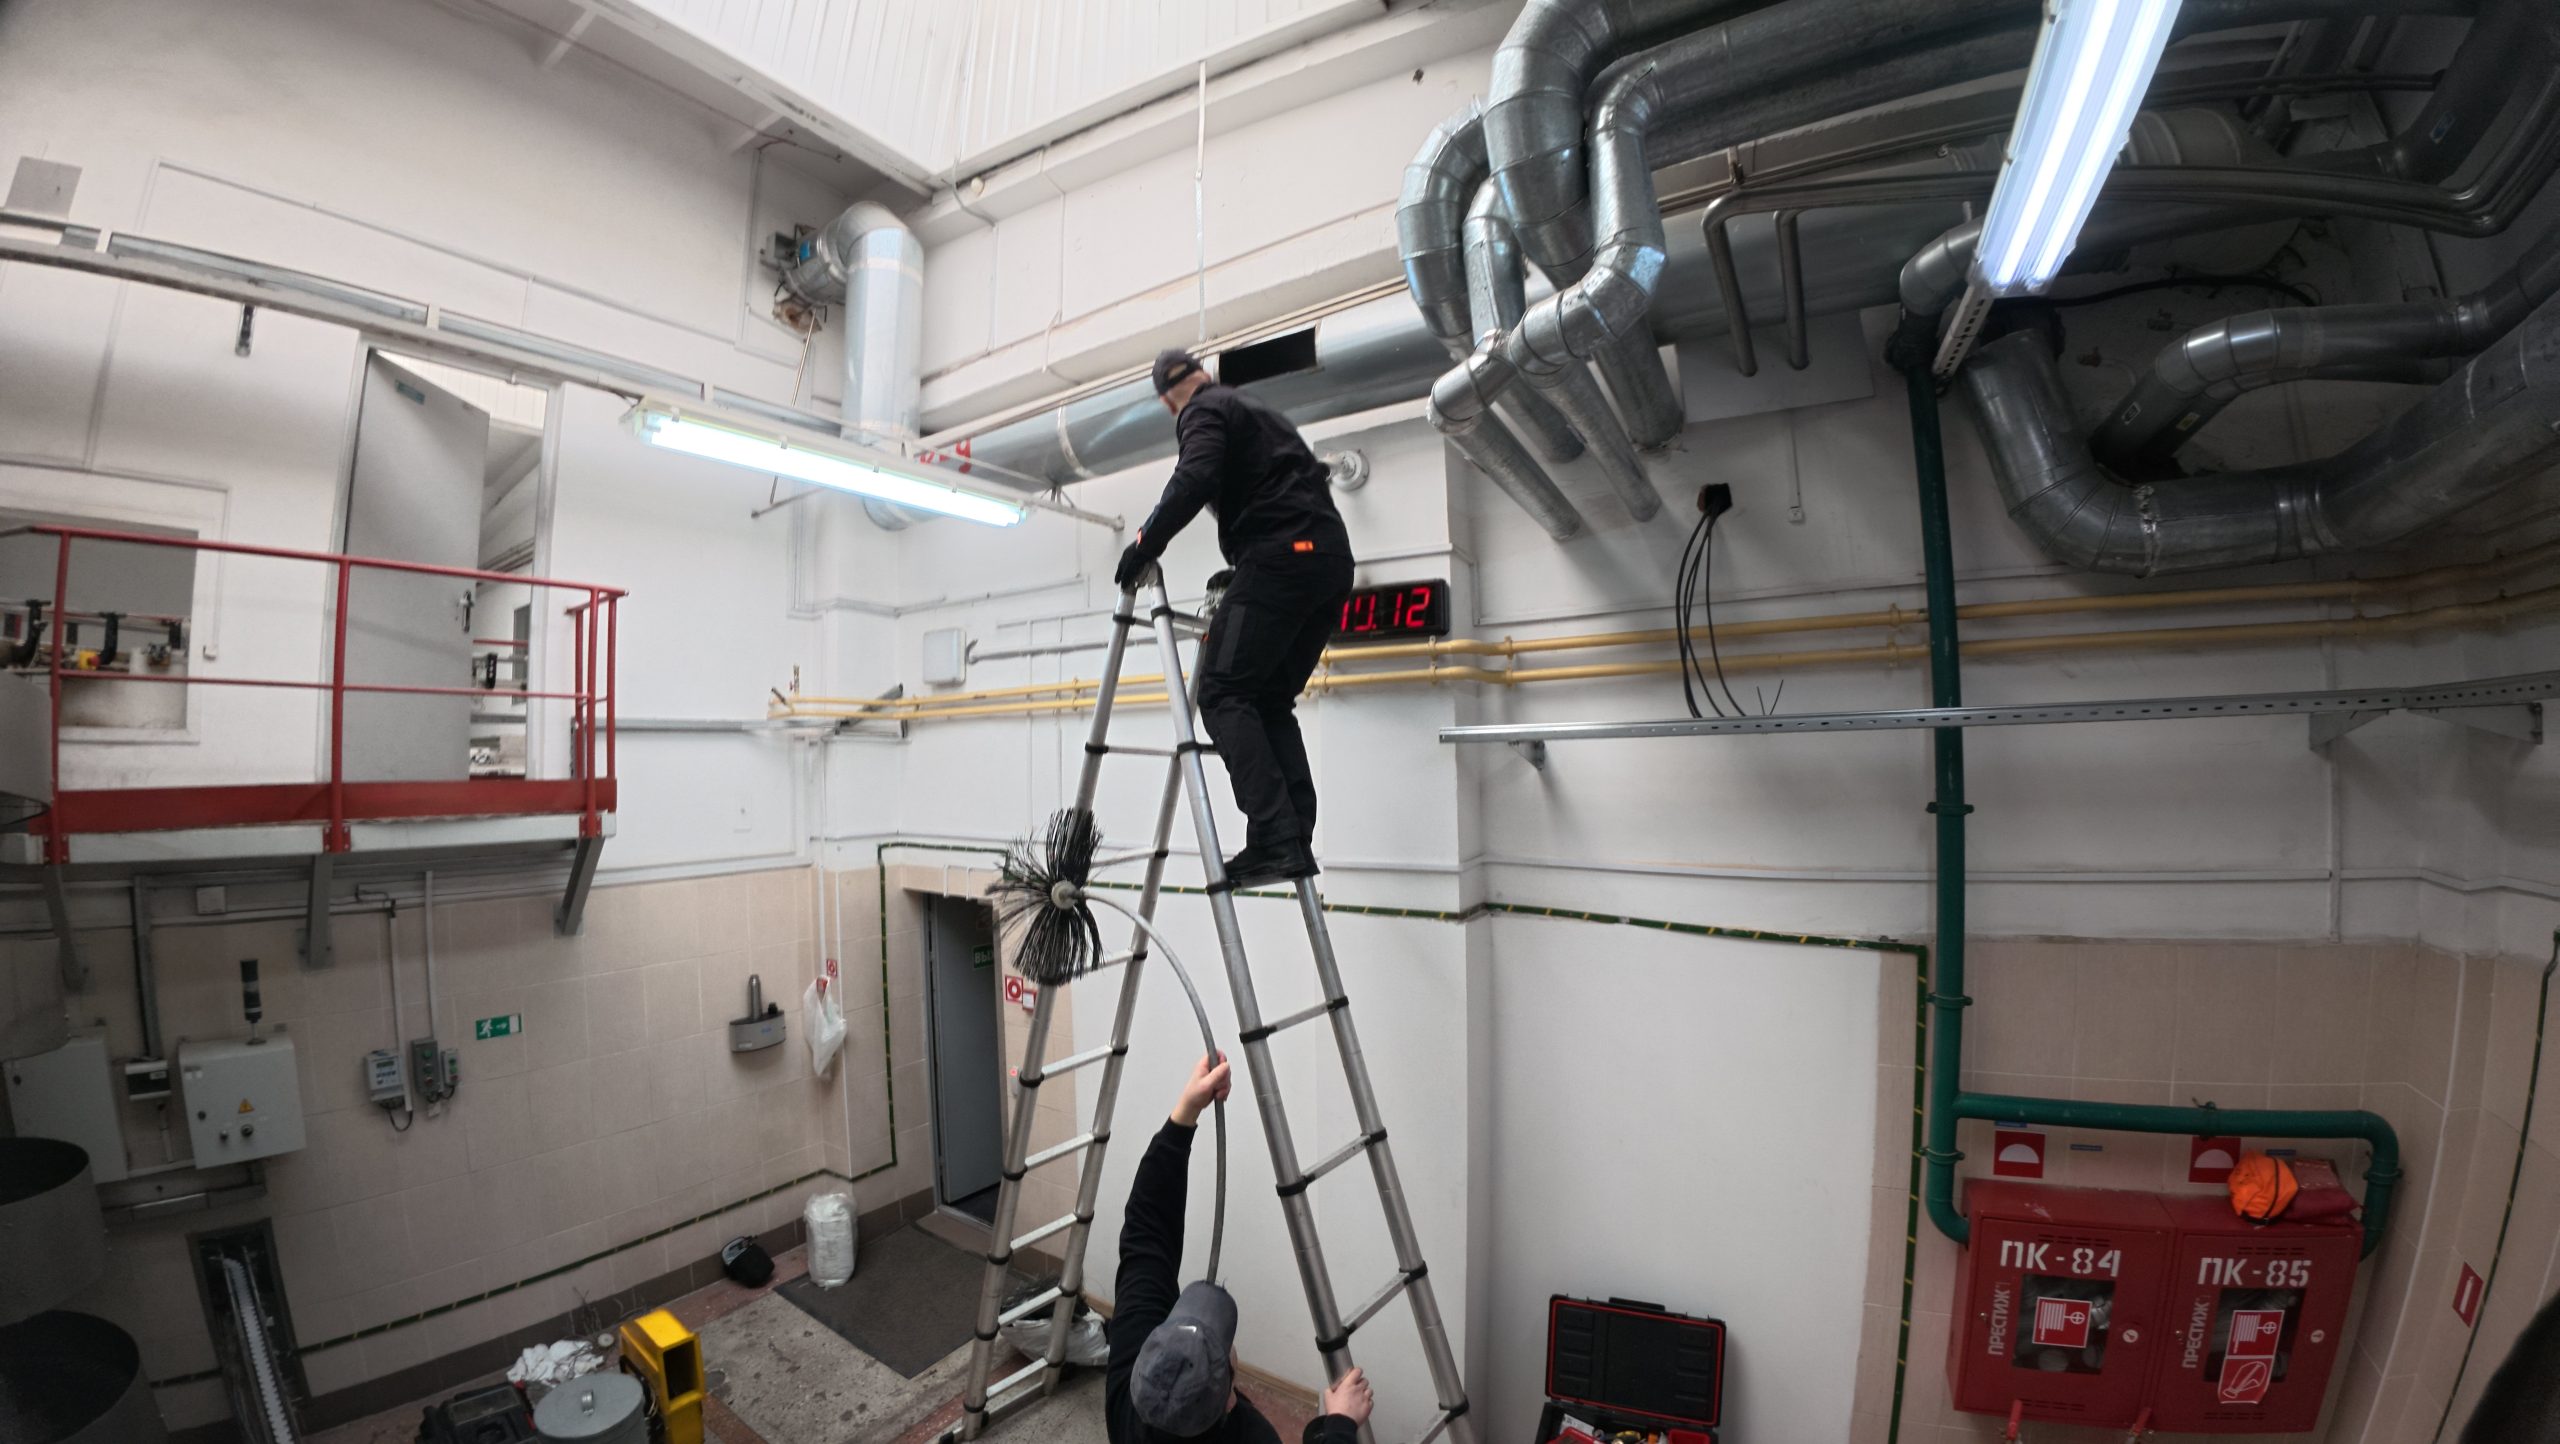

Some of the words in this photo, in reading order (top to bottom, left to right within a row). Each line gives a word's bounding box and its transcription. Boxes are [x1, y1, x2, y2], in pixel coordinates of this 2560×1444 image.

[2000, 1239, 2121, 1278] ПК-84
[2197, 1257, 2312, 1287] ПК-85
[1987, 1287, 2010, 1356] ПРЕСТИЖ
[2182, 1301, 2210, 1369] ПРЕСТИЖ
